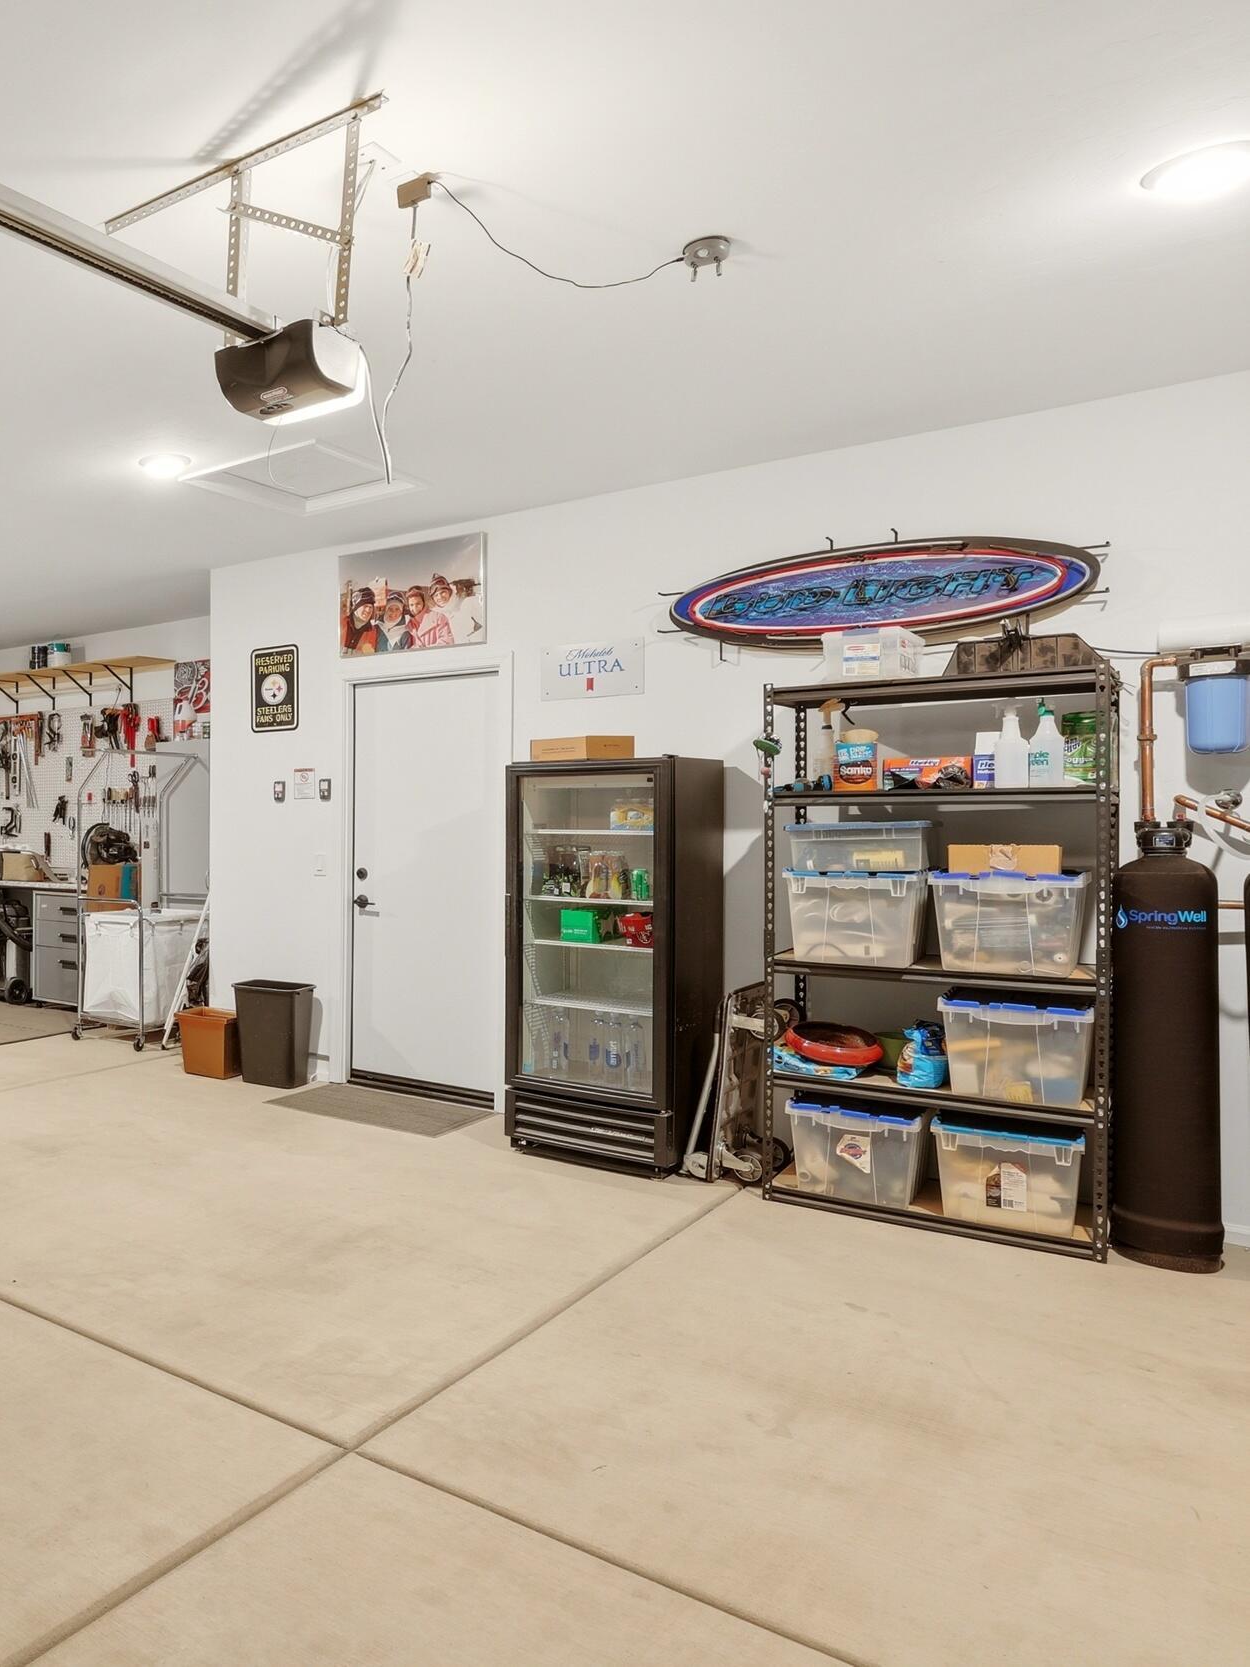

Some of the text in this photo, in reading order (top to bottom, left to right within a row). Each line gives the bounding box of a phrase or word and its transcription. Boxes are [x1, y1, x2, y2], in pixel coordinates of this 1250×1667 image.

[703, 564, 1038, 619] BUD LIGHT
[255, 653, 293, 666] RESERVED
[258, 663, 290, 675] PARKING
[558, 658, 625, 677] ULTRA
[256, 704, 292, 716] STEELERS
[256, 713, 293, 723] FANS ONLY
[1129, 909, 1207, 926] SpringWell
